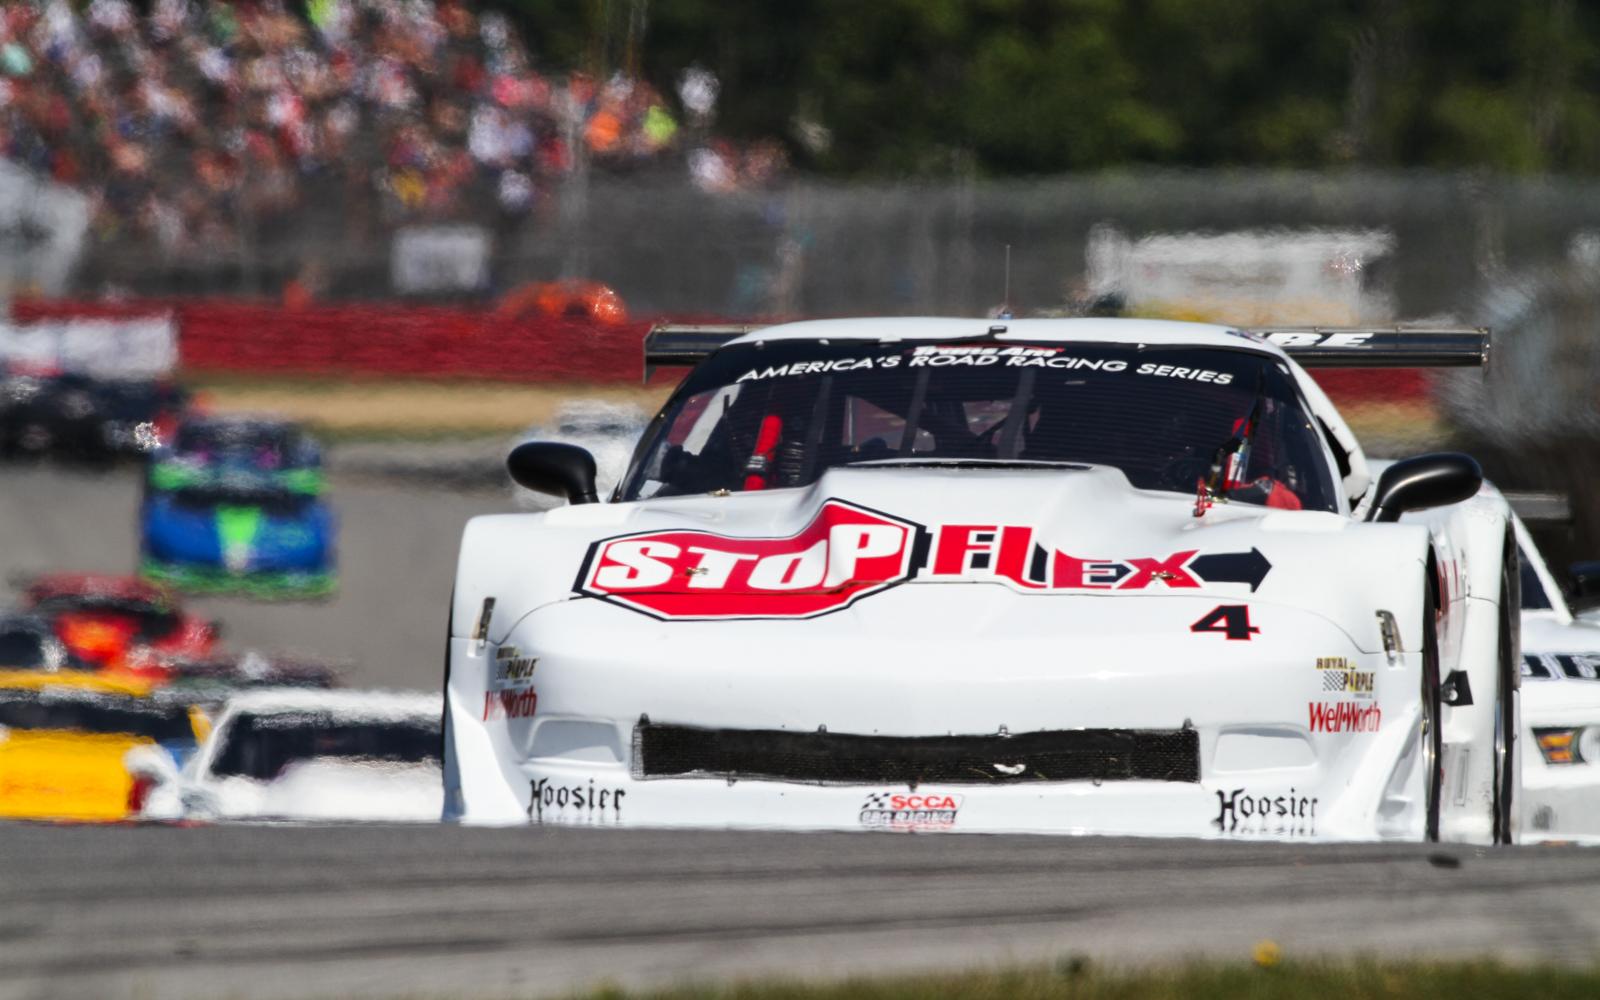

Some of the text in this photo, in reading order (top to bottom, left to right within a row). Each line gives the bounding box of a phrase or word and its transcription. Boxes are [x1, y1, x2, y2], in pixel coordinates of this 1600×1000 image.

[1257, 332, 1374, 347] BE
[735, 354, 1234, 386] AMERICA'S ROAD RACING SERIES
[595, 524, 1202, 591] STOP FLEX
[1190, 604, 1261, 641] 4
[527, 777, 626, 822] Hoosier
[890, 795, 956, 810] SCCA
[1211, 787, 1319, 832] Hoosier
